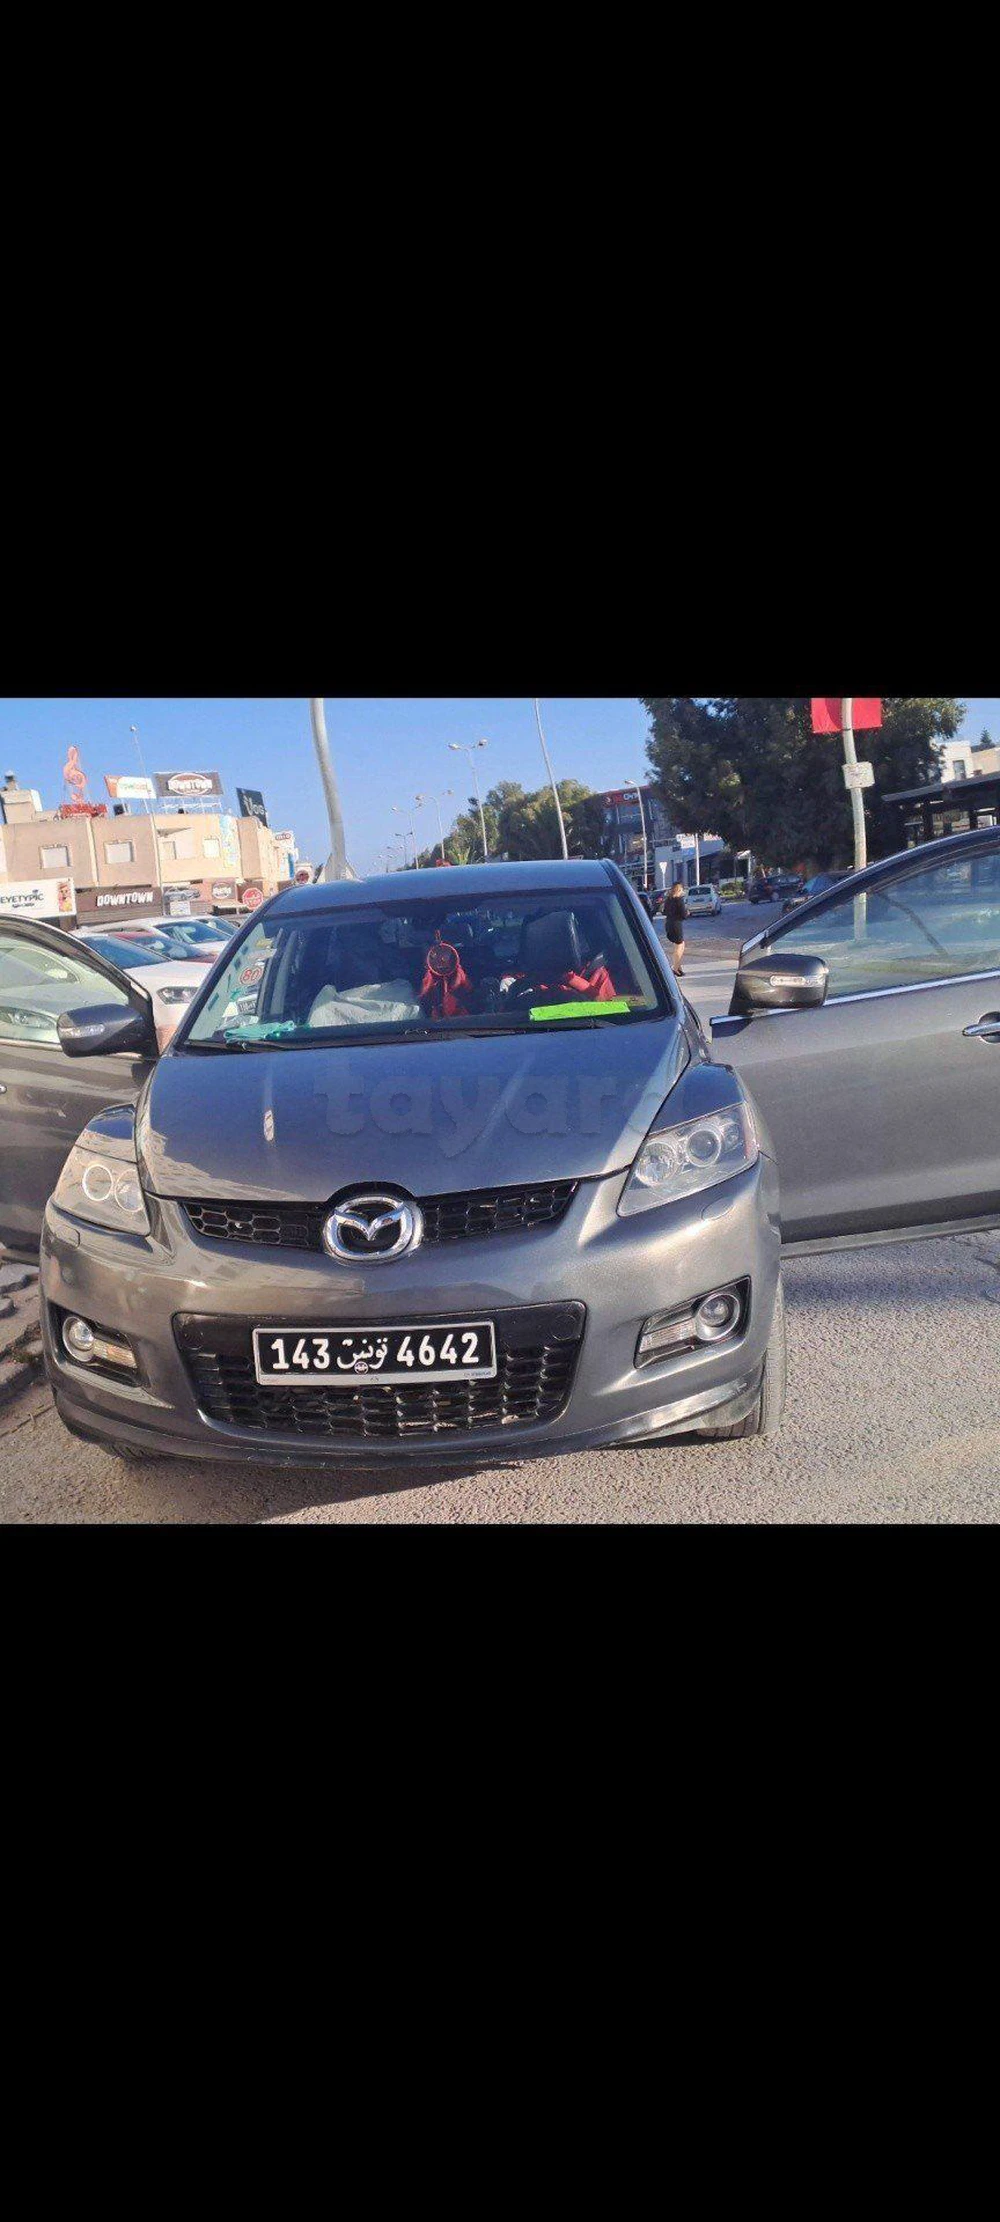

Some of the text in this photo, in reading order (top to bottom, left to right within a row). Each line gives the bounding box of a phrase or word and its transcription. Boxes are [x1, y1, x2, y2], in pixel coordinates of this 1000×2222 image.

[97, 891, 153, 907] DOWNTOWN
[271, 1332, 479, 1370] 143 تونس 4642
